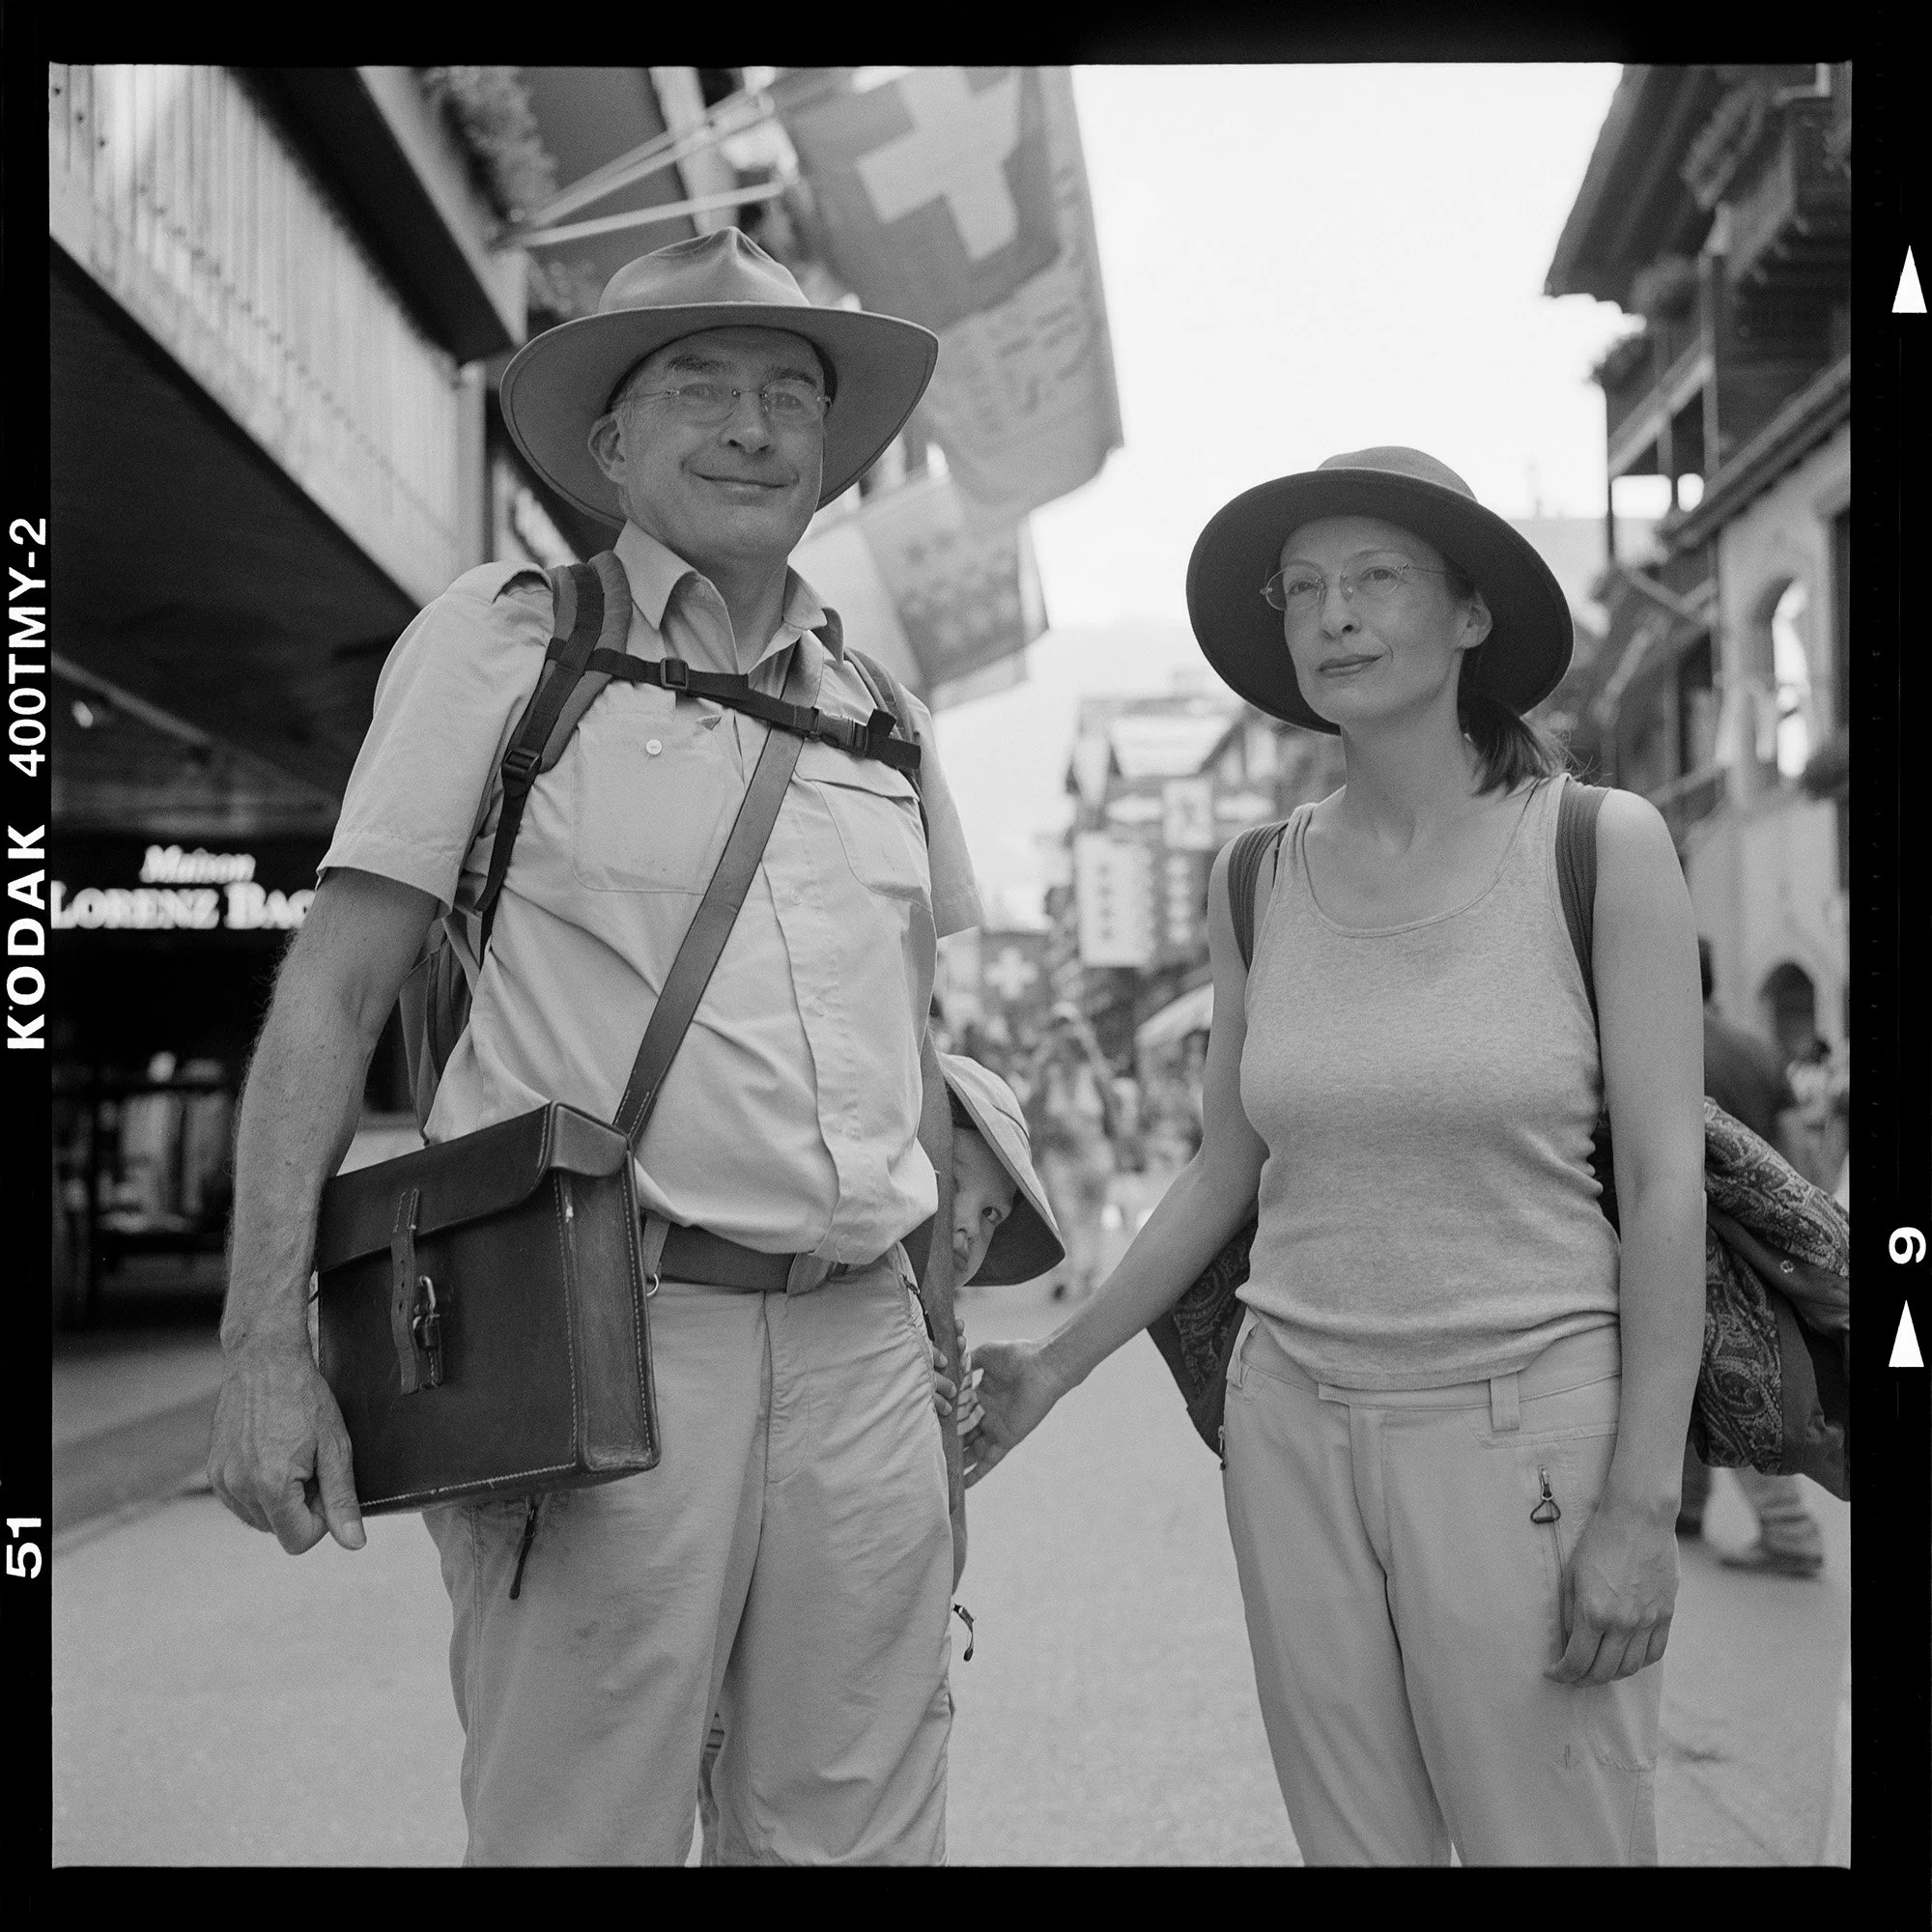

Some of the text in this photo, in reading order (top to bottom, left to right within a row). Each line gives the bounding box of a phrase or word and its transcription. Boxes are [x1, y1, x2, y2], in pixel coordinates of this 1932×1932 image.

[7, 518, 46, 1050] KODAK 400TMY-2
[1888, 1226, 1927, 1265] 9
[6, 1517, 43, 1579] 51
